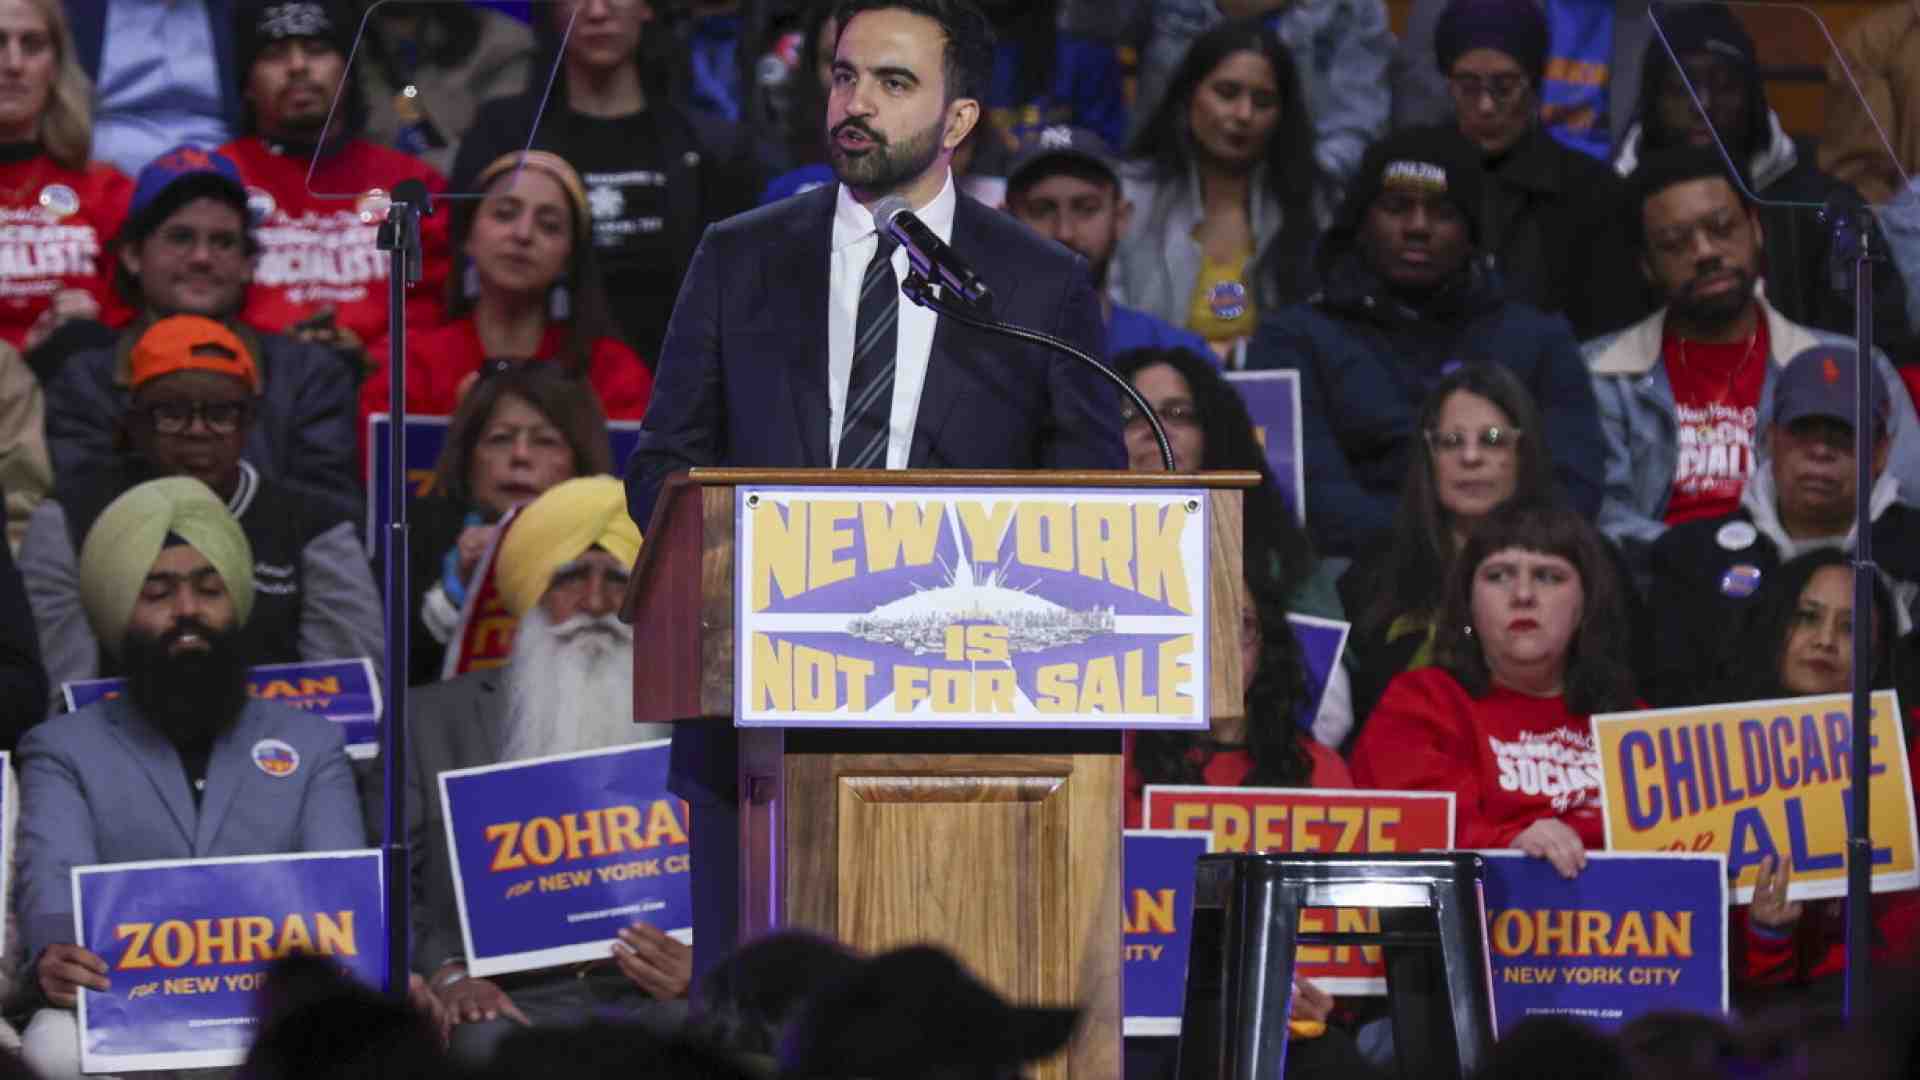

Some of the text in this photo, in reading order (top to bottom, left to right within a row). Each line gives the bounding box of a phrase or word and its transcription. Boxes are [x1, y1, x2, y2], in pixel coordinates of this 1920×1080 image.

[753, 501, 1193, 615] NEW YORK
[945, 625, 1009, 661] IS
[752, 632, 1194, 714] NOT FOR SALE
[484, 799, 690, 873] ZOHRA
[539, 869, 592, 893] NEW
[596, 857, 661, 882] YORK
[664, 855, 690, 874] CI
[115, 910, 359, 971] ZOHRAN
[1123, 944, 1165, 961] ITY
[1489, 908, 1695, 960] OHRAN
[164, 977, 220, 996] NEW
[1503, 966, 1682, 986] NEW YORK CITY
